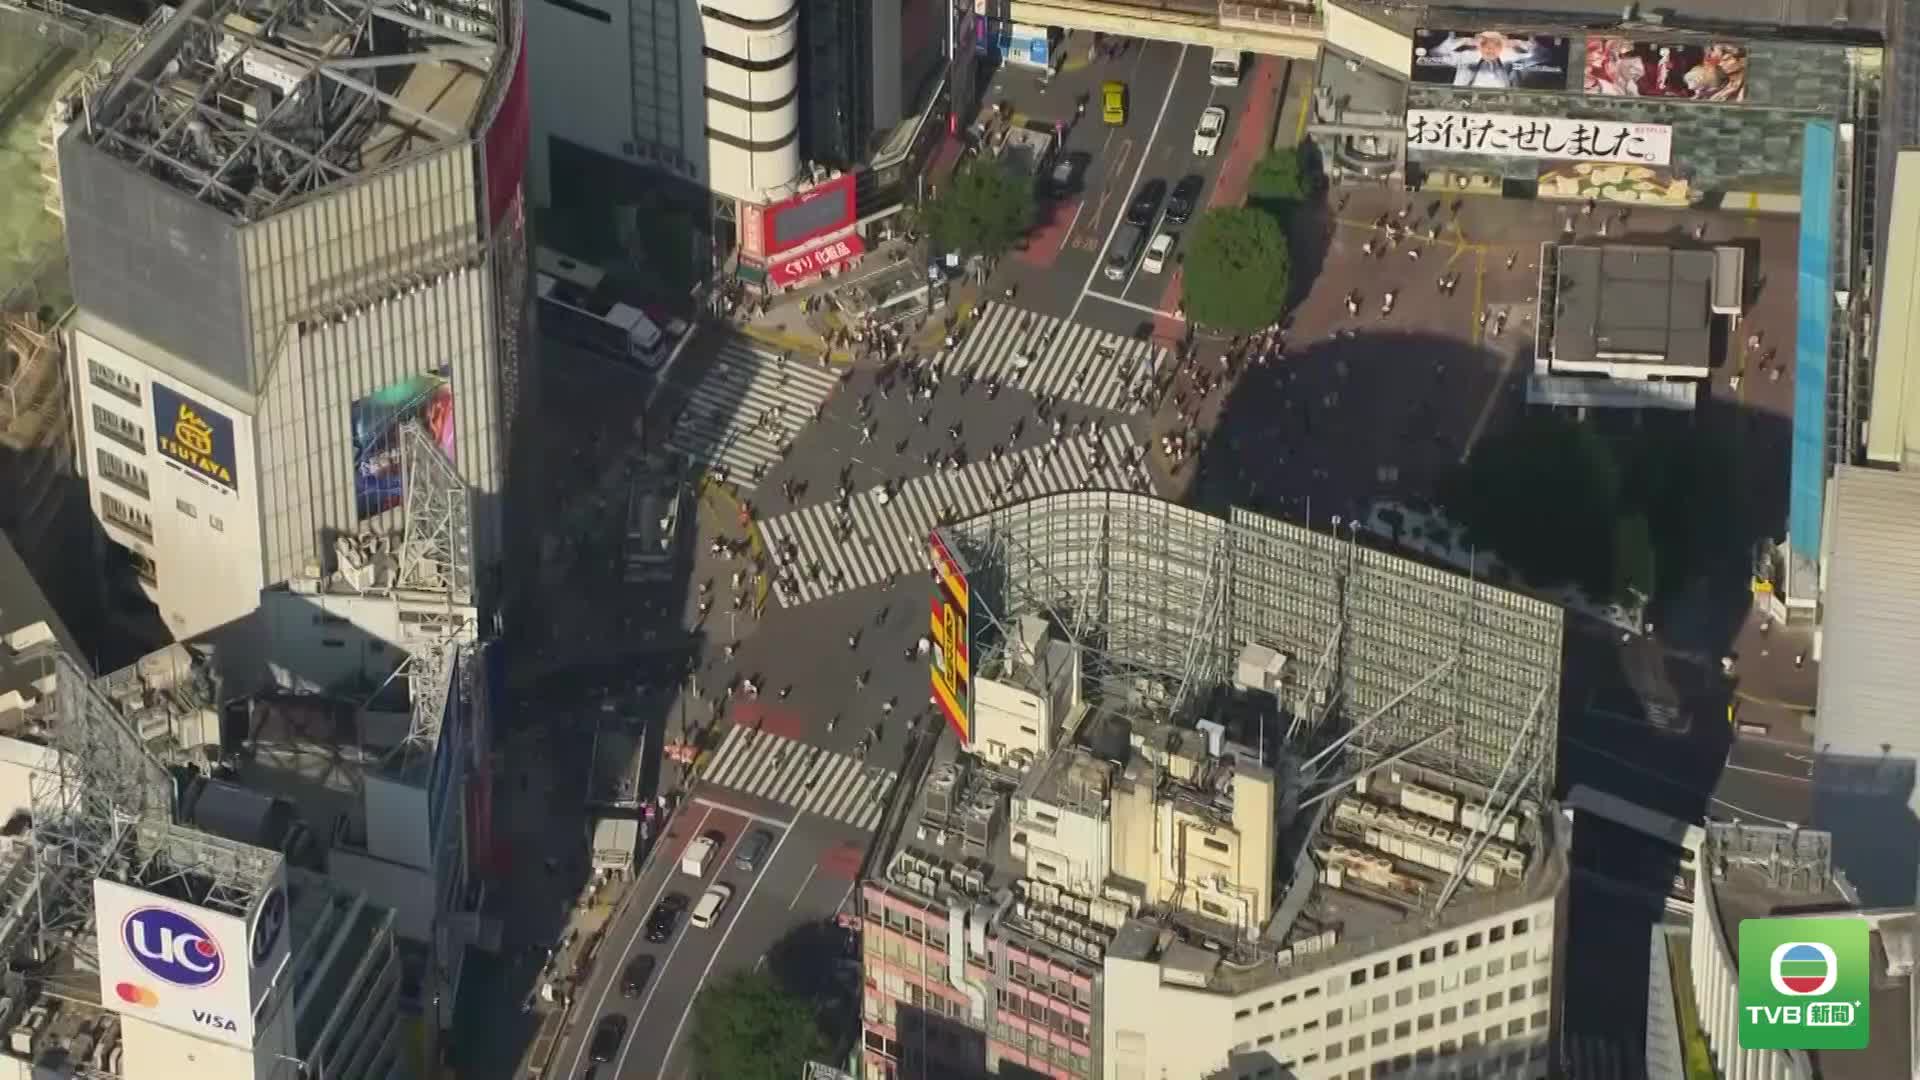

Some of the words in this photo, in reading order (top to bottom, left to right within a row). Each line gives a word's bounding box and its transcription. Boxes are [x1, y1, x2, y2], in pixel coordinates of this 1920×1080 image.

[1407, 115, 1656, 161] お待たせしました。
[785, 256, 813, 276] くすり
[159, 436, 231, 481] TSUTAYA
[192, 1009, 237, 1032] VISA
